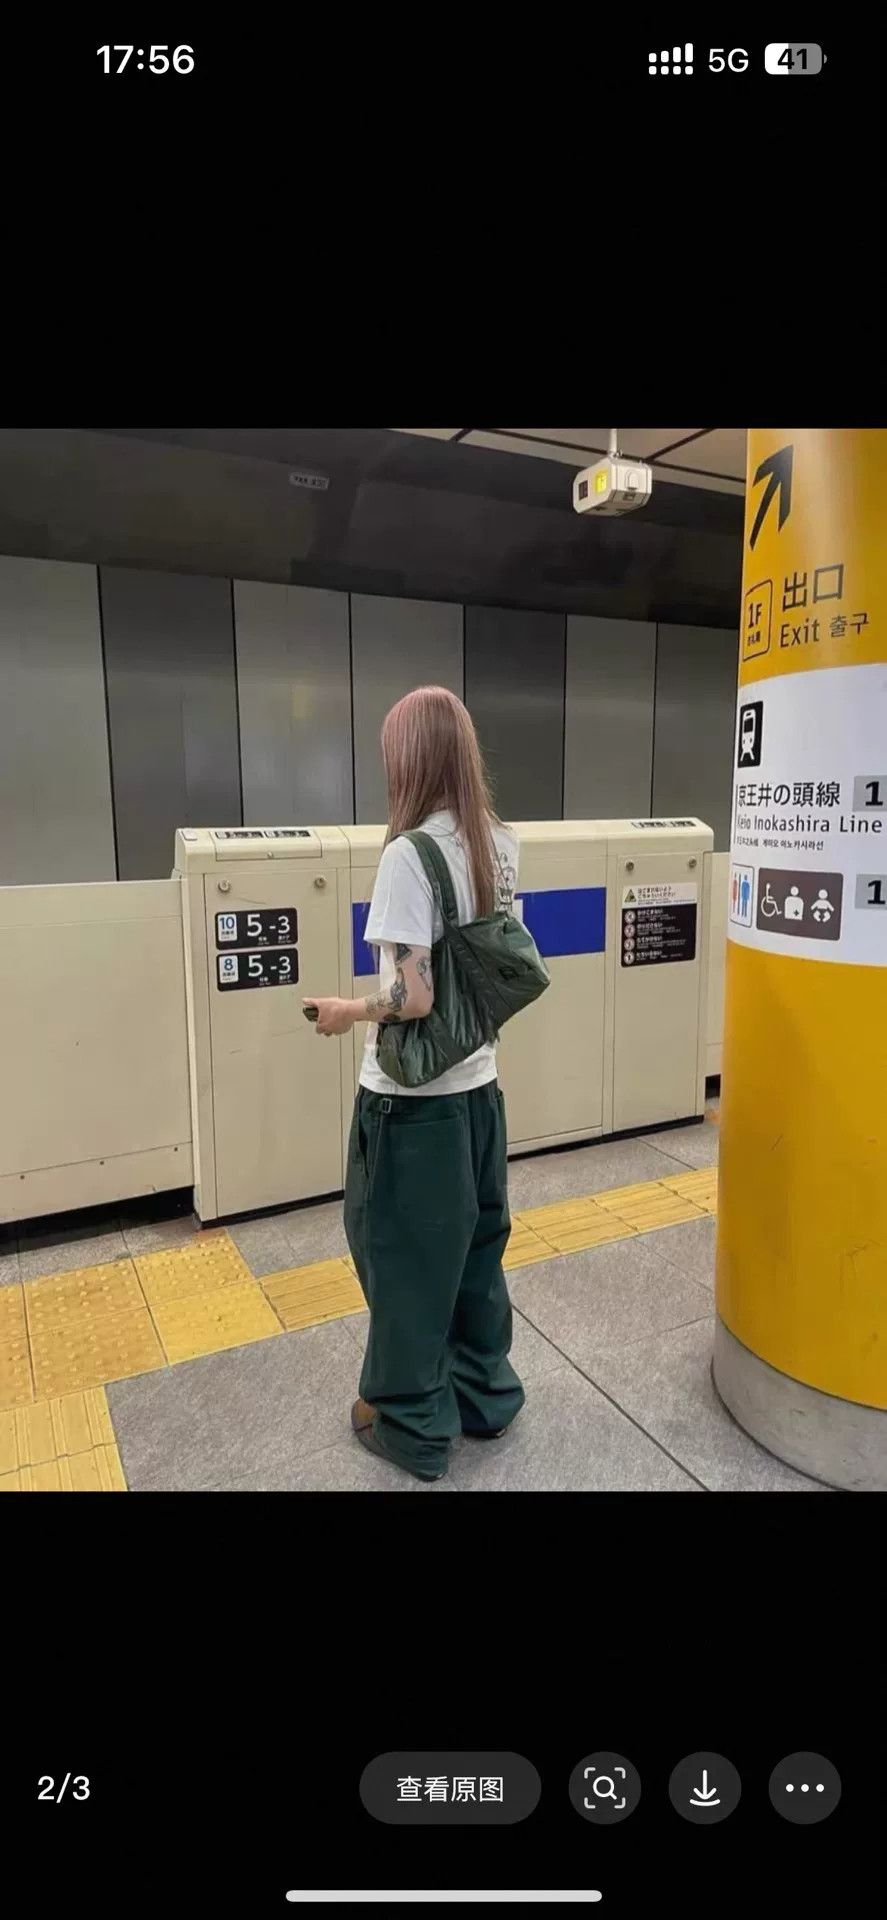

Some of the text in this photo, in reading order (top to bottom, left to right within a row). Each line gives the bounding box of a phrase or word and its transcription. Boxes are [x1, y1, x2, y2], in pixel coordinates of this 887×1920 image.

[782, 563, 844, 612] 出口
[748, 603, 762, 628] 1F
[830, 612, 869, 638] 출구
[780, 618, 820, 648] Exit
[738, 781, 841, 807] 京王井の頭線
[865, 781, 884, 806] 1
[754, 814, 830, 833] Inokashira
[839, 815, 883, 833] Line
[867, 879, 886, 905] 1
[219, 917, 235, 930] 10
[247, 914, 263, 937] 5
[224, 958, 233, 971] 8
[248, 954, 264, 977] 5
